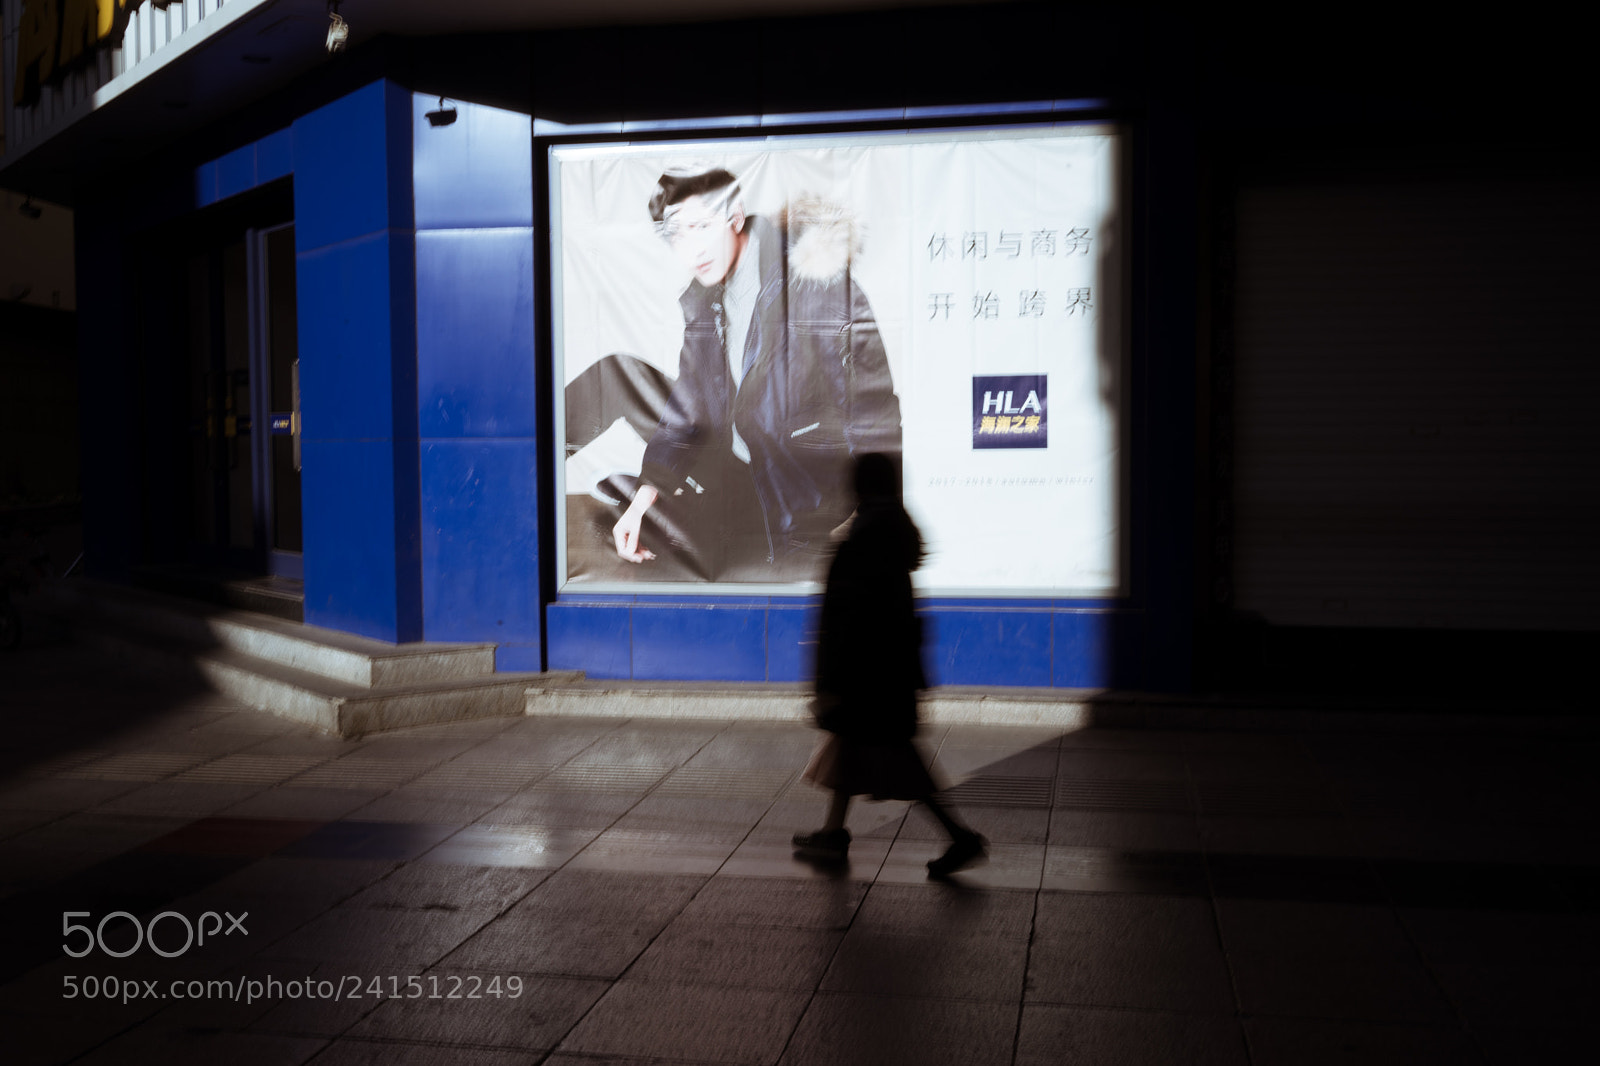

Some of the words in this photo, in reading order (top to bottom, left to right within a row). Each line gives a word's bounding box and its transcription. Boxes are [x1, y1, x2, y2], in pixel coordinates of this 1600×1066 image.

[927, 227, 1094, 262] 休闲与商务
[928, 288, 1093, 321] 开始跨界
[982, 390, 1041, 414] HLA
